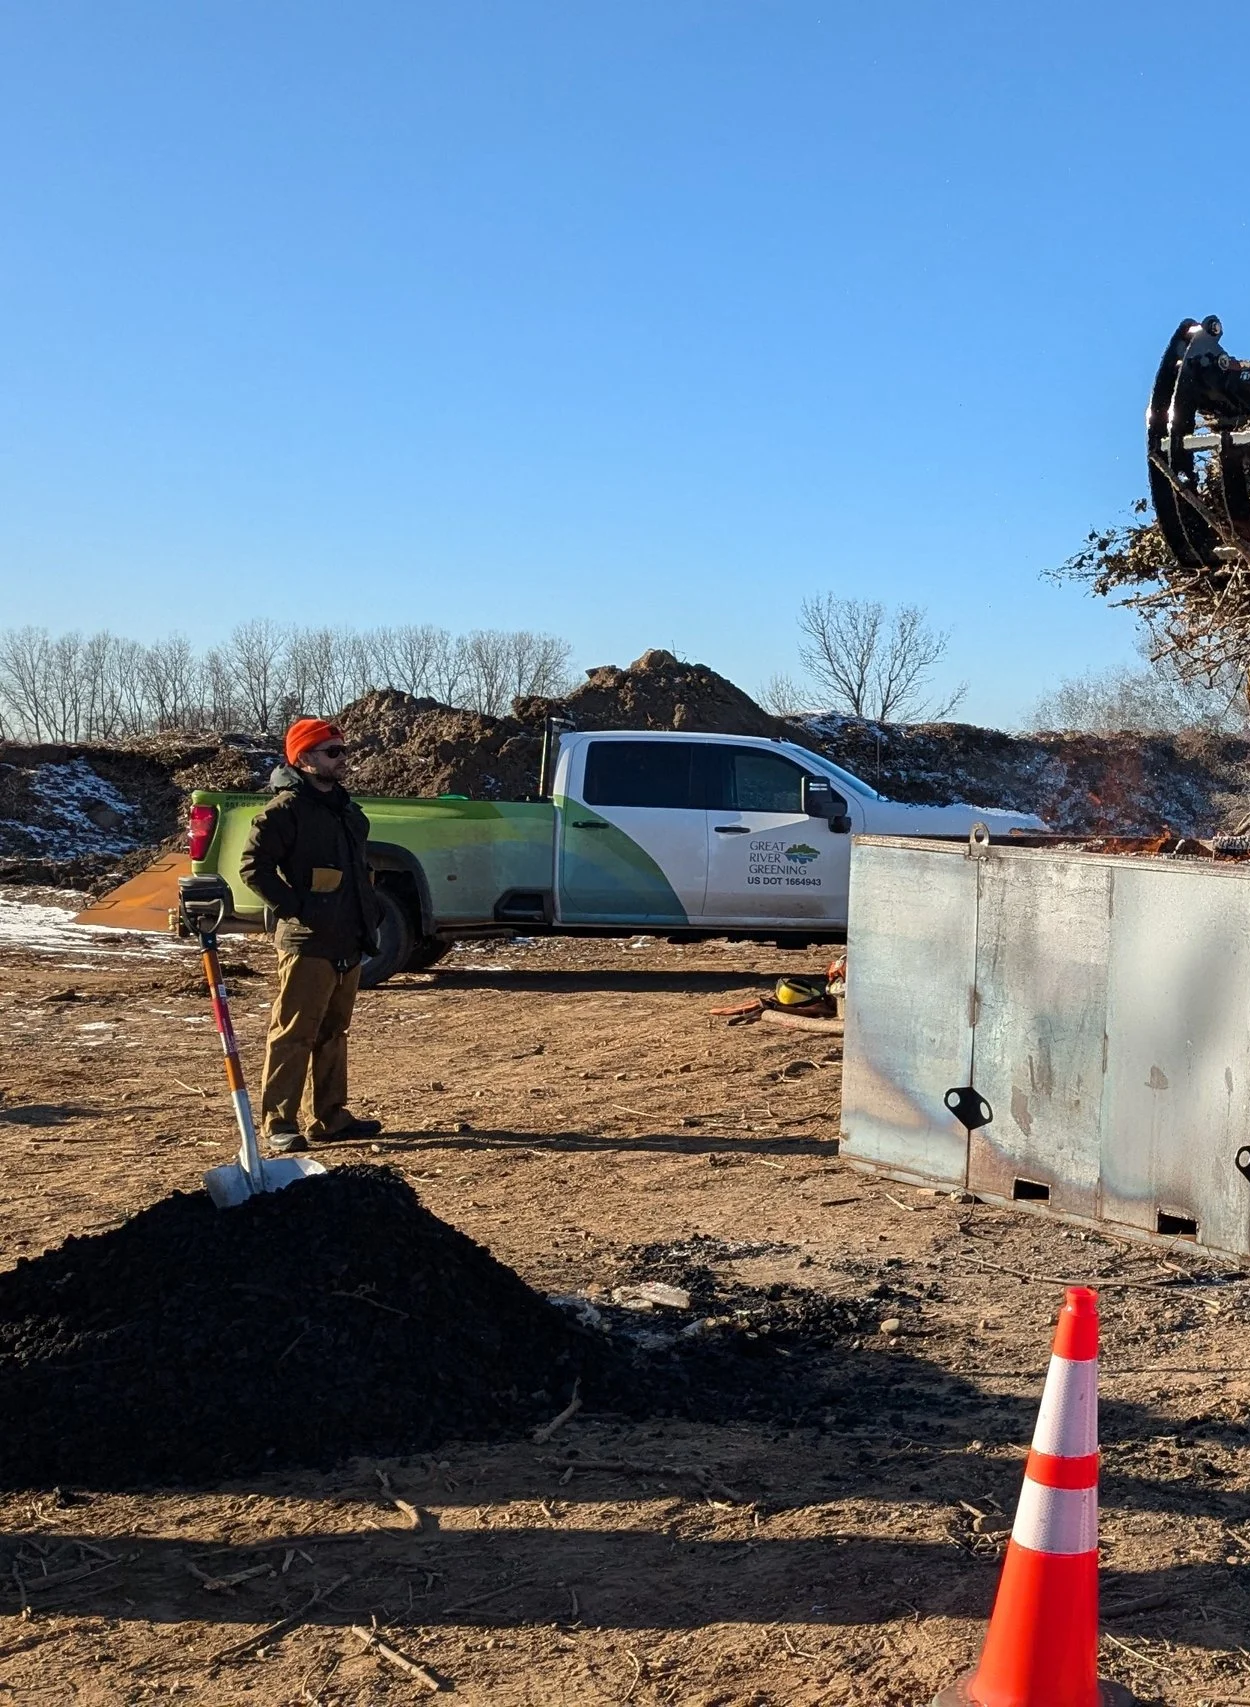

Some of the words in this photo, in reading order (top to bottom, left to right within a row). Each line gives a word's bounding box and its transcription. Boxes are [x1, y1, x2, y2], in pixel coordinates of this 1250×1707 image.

[749, 841, 786, 851] GREAT
[749, 853, 781, 863] RIVER
[749, 864, 807, 875] GREENING
[747, 876, 761, 885] US
[763, 877, 783, 886] DOT
[785, 877, 822, 887] 1664943
